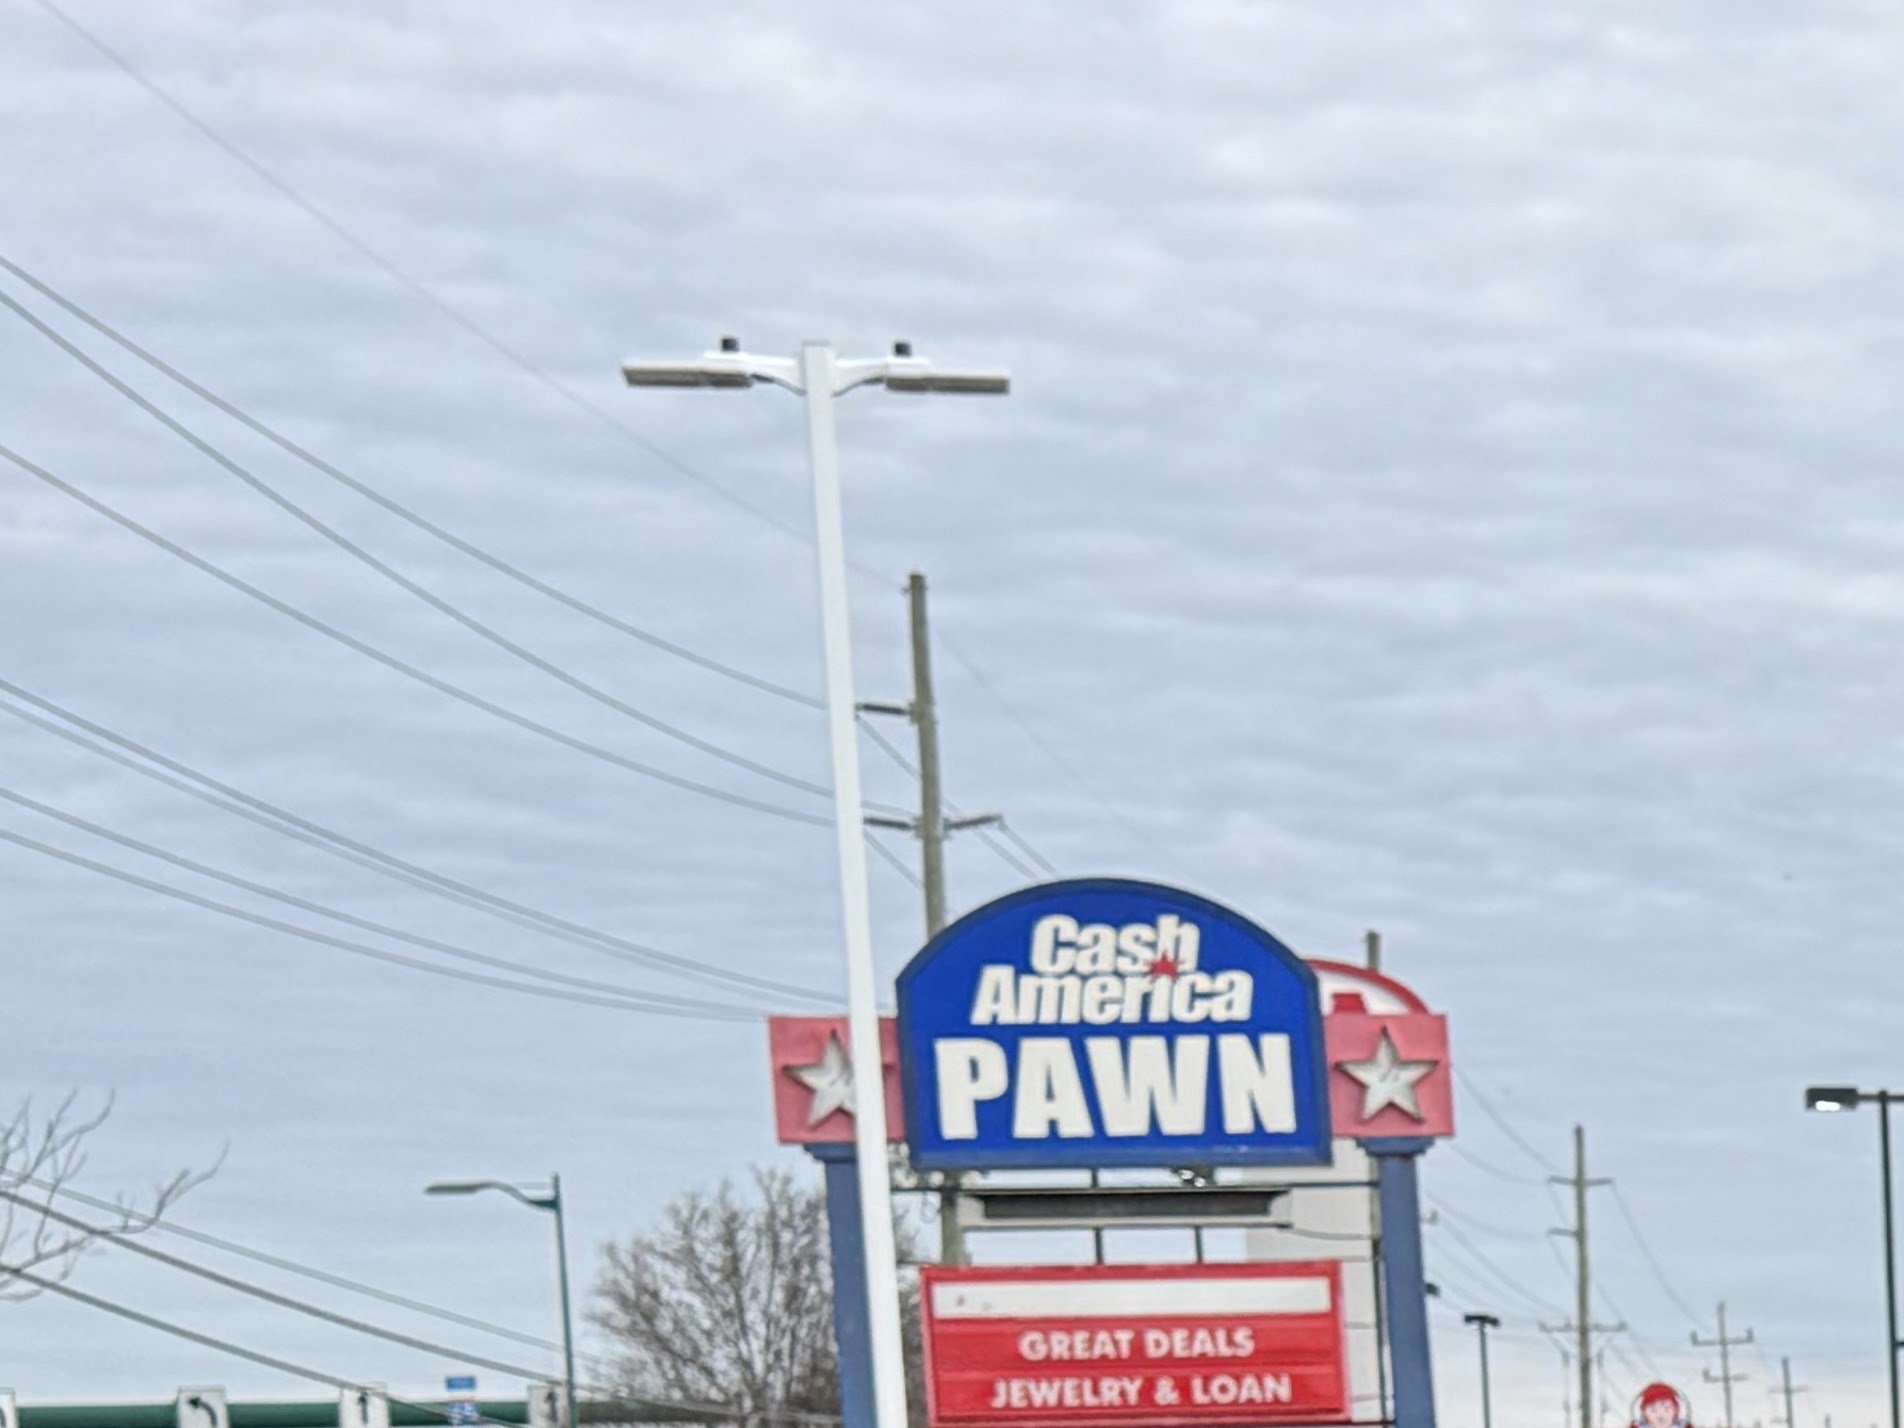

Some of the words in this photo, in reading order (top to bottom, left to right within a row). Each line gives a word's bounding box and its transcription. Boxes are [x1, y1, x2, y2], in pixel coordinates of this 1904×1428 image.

[1031, 914, 1199, 976] Cash
[970, 964, 1254, 1025] America
[934, 1033, 1297, 1140] PAWN
[1018, 1329, 1135, 1361] GREAT
[1144, 1327, 1255, 1358] DEALS
[991, 1375, 1144, 1408] JEWELRY
[1154, 1376, 1181, 1405] &
[1190, 1373, 1292, 1404] LOAN
